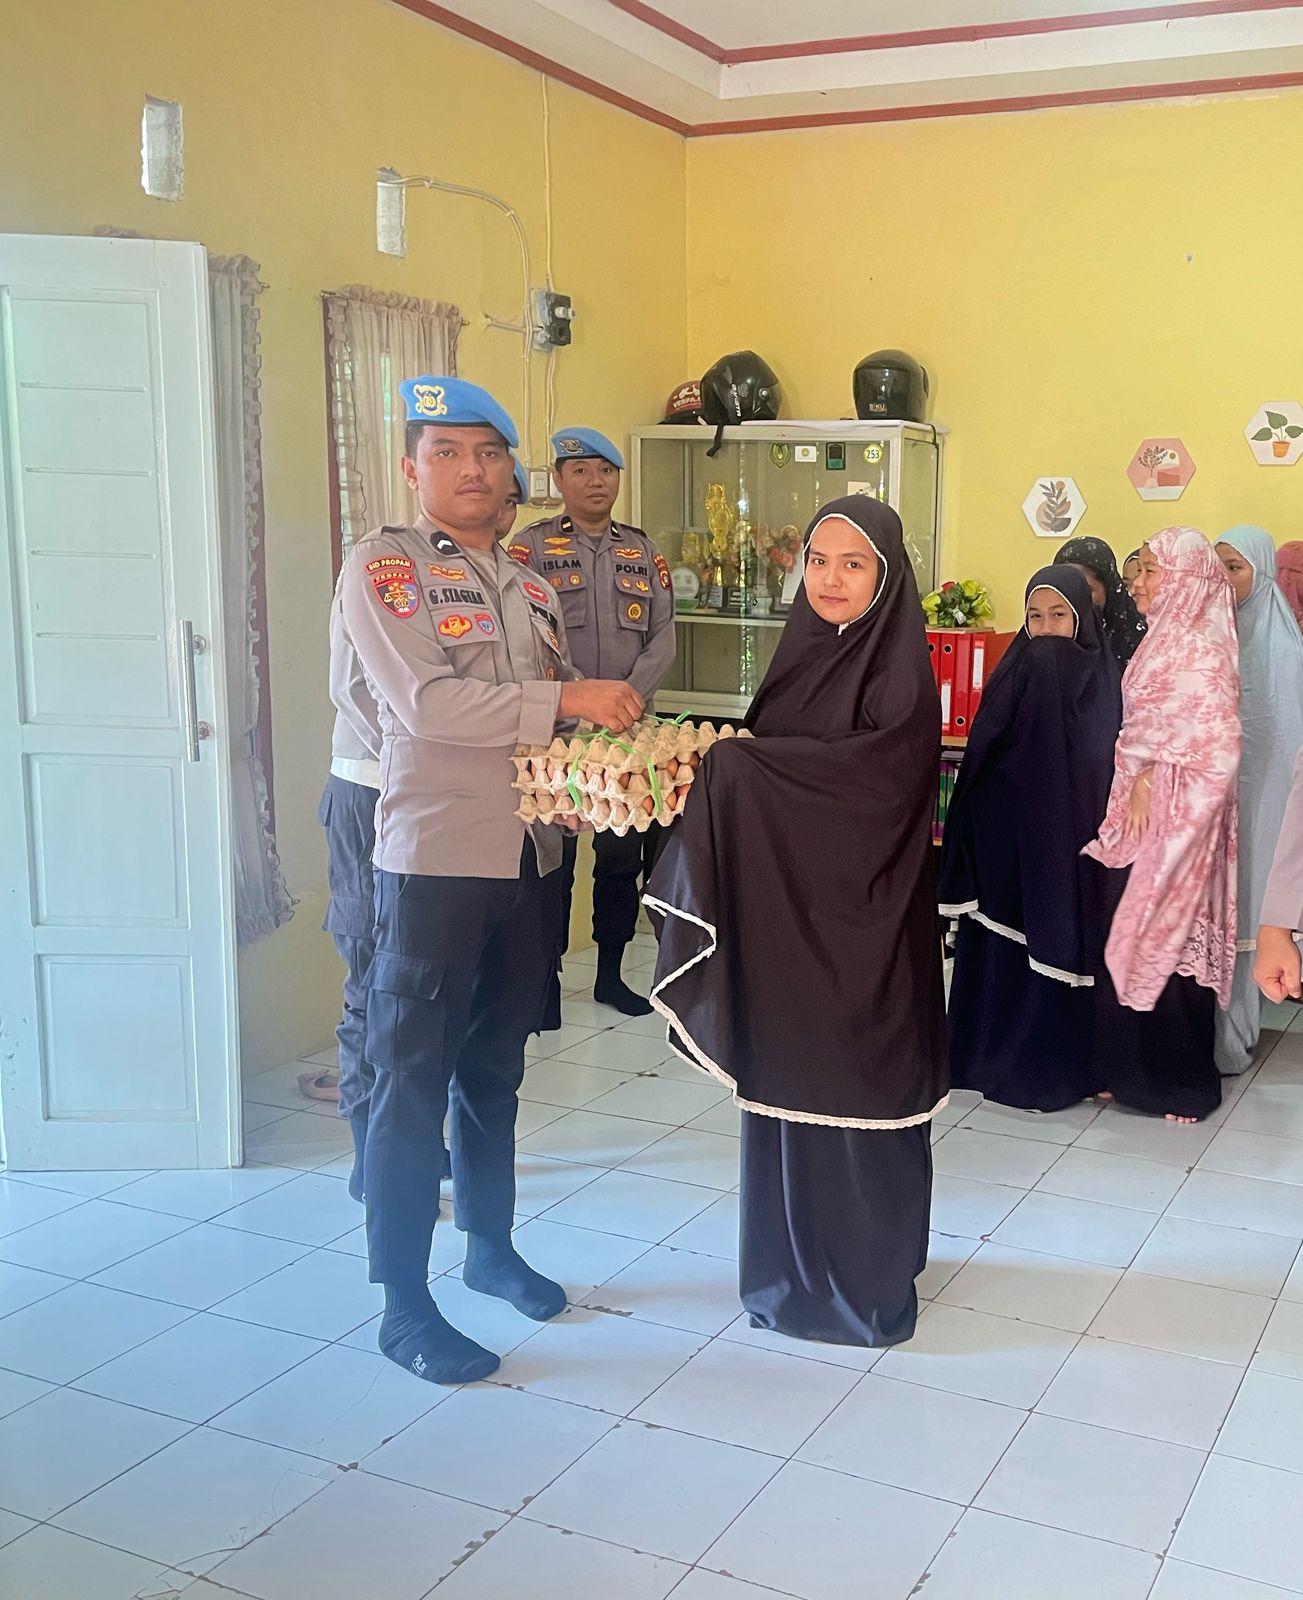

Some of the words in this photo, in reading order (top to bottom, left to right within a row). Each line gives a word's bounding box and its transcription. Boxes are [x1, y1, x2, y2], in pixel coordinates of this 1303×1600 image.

[866, 449, 880, 460] 253
[381, 559, 411, 568] PROPAM
[543, 559, 582, 571] ISLAM
[615, 563, 648, 577] POLRI
[375, 572, 410, 582] PROPAM
